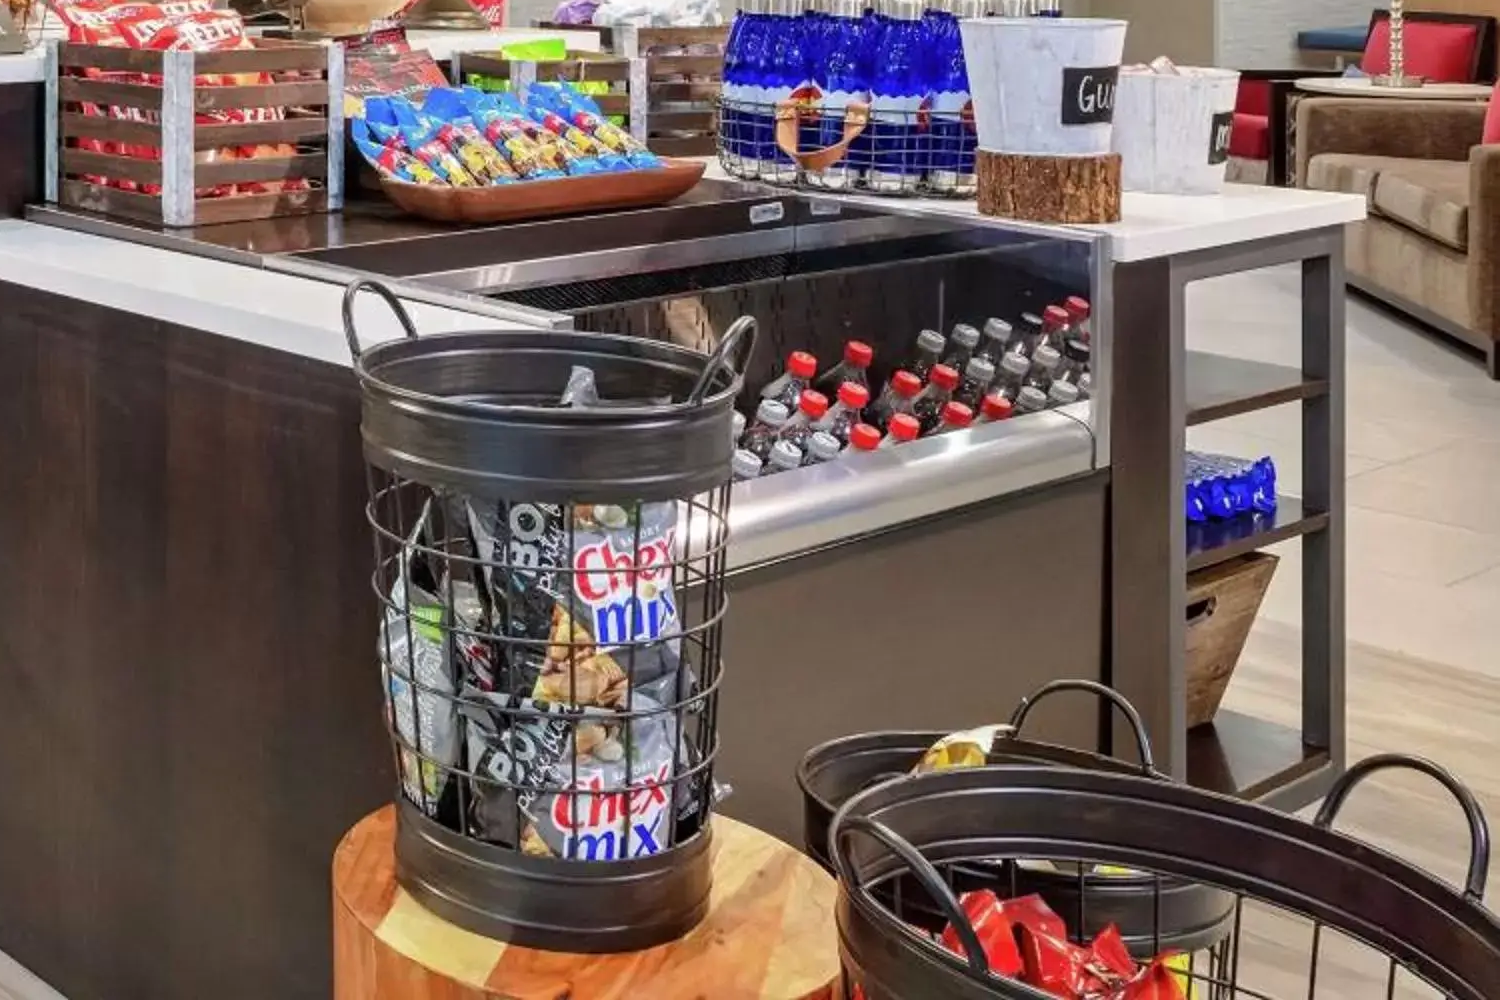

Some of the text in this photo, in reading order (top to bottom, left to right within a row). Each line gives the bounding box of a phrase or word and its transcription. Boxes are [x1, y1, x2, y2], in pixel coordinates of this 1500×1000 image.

[574, 528, 678, 603] Chex
[596, 589, 676, 643] mix
[553, 763, 670, 830] Chex
